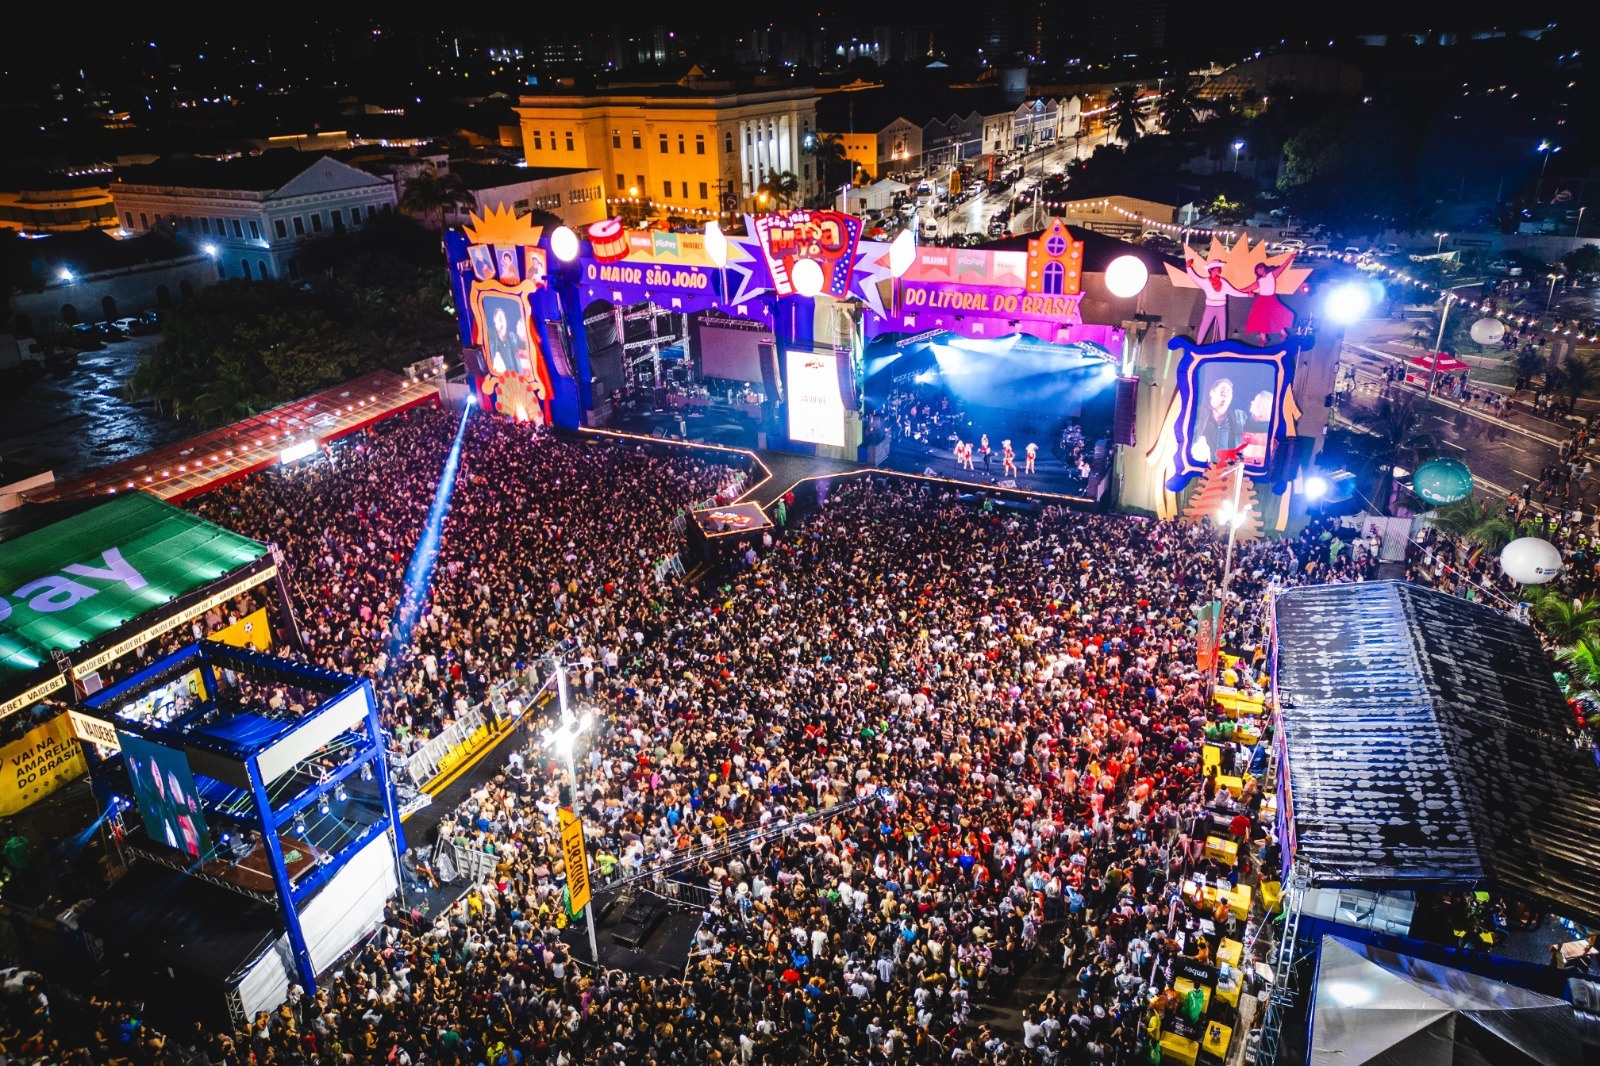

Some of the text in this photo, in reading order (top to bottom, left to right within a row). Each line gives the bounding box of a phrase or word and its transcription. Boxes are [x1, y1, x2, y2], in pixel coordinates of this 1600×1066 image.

[922, 255, 948, 266] BRAHMA
[958, 257, 985, 267] PicPay
[587, 264, 708, 289] O MAIOR SÃO JOÃO
[905, 288, 1078, 317] DO LITORAL DO BRASIL
[0, 546, 148, 621] ay
[76, 652, 112, 675] VAIDEBET
[114, 634, 148, 655] VAIDEBET
[150, 616, 182, 636] VAIDEBET
[184, 599, 214, 618] VAIDEBET
[219, 583, 247, 601] VAIDEBET
[1201, 619, 1210, 656] PicPay
[27, 677, 66, 701] VAIDEBET
[11, 736, 56, 767] VAI NA
[17, 746, 82, 790] DO BRASIL
[565, 833, 586, 899] VAIDEBET
